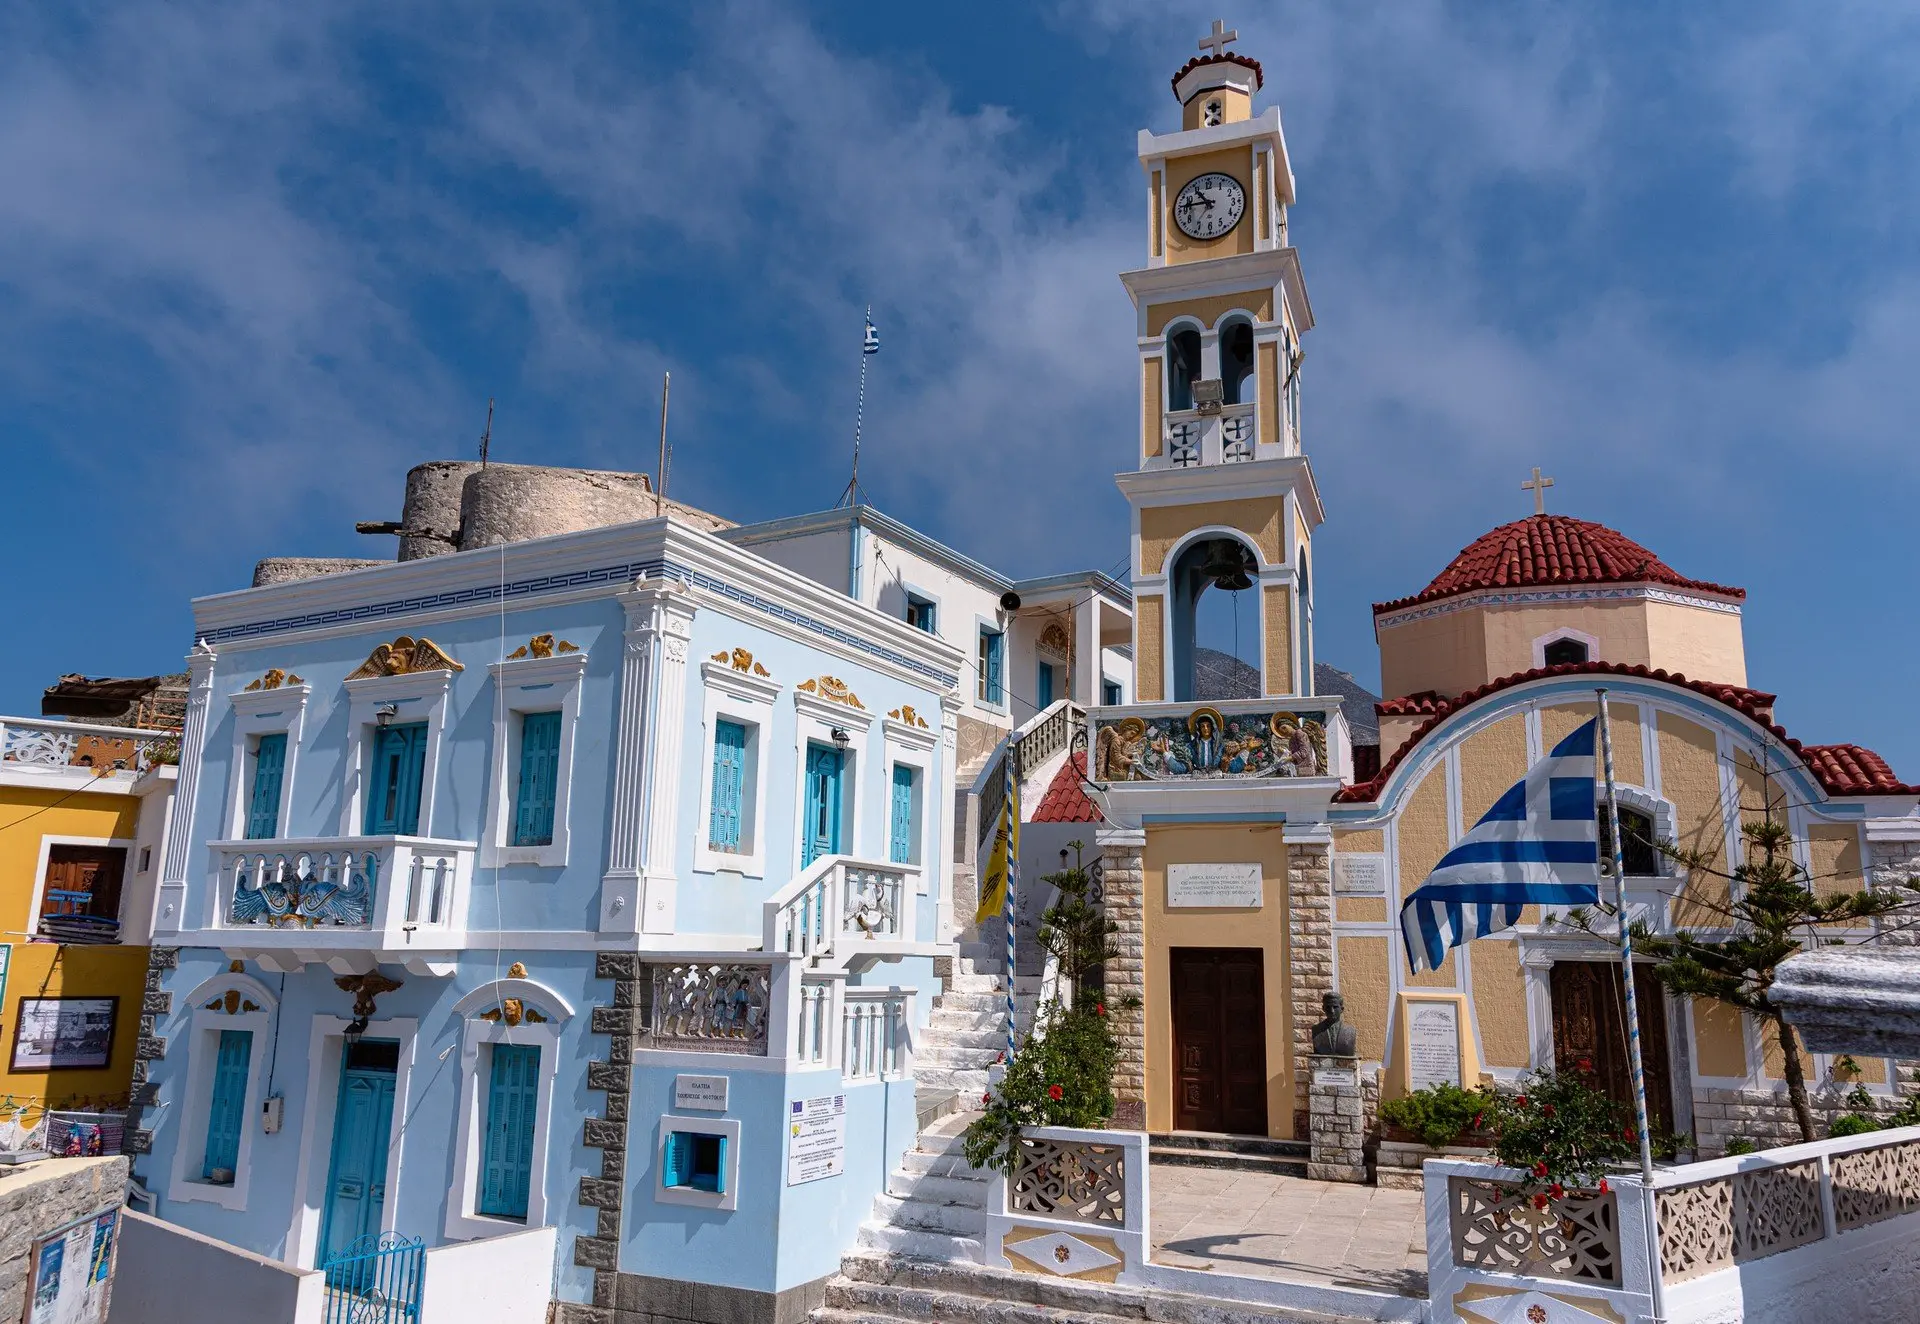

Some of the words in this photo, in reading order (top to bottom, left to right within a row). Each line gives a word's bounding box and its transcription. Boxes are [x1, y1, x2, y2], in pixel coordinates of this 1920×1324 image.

[1205, 181, 1212, 190] 12
[1218, 182, 1222, 190] 1
[1227, 189, 1232, 197] 2
[1231, 197, 1236, 206] 3
[1228, 207, 1233, 216] 4
[1187, 215, 1192, 224] 8
[1218, 217, 1223, 227] 5
[1196, 221, 1201, 230] 7
[1207, 222, 1213, 230] 6
